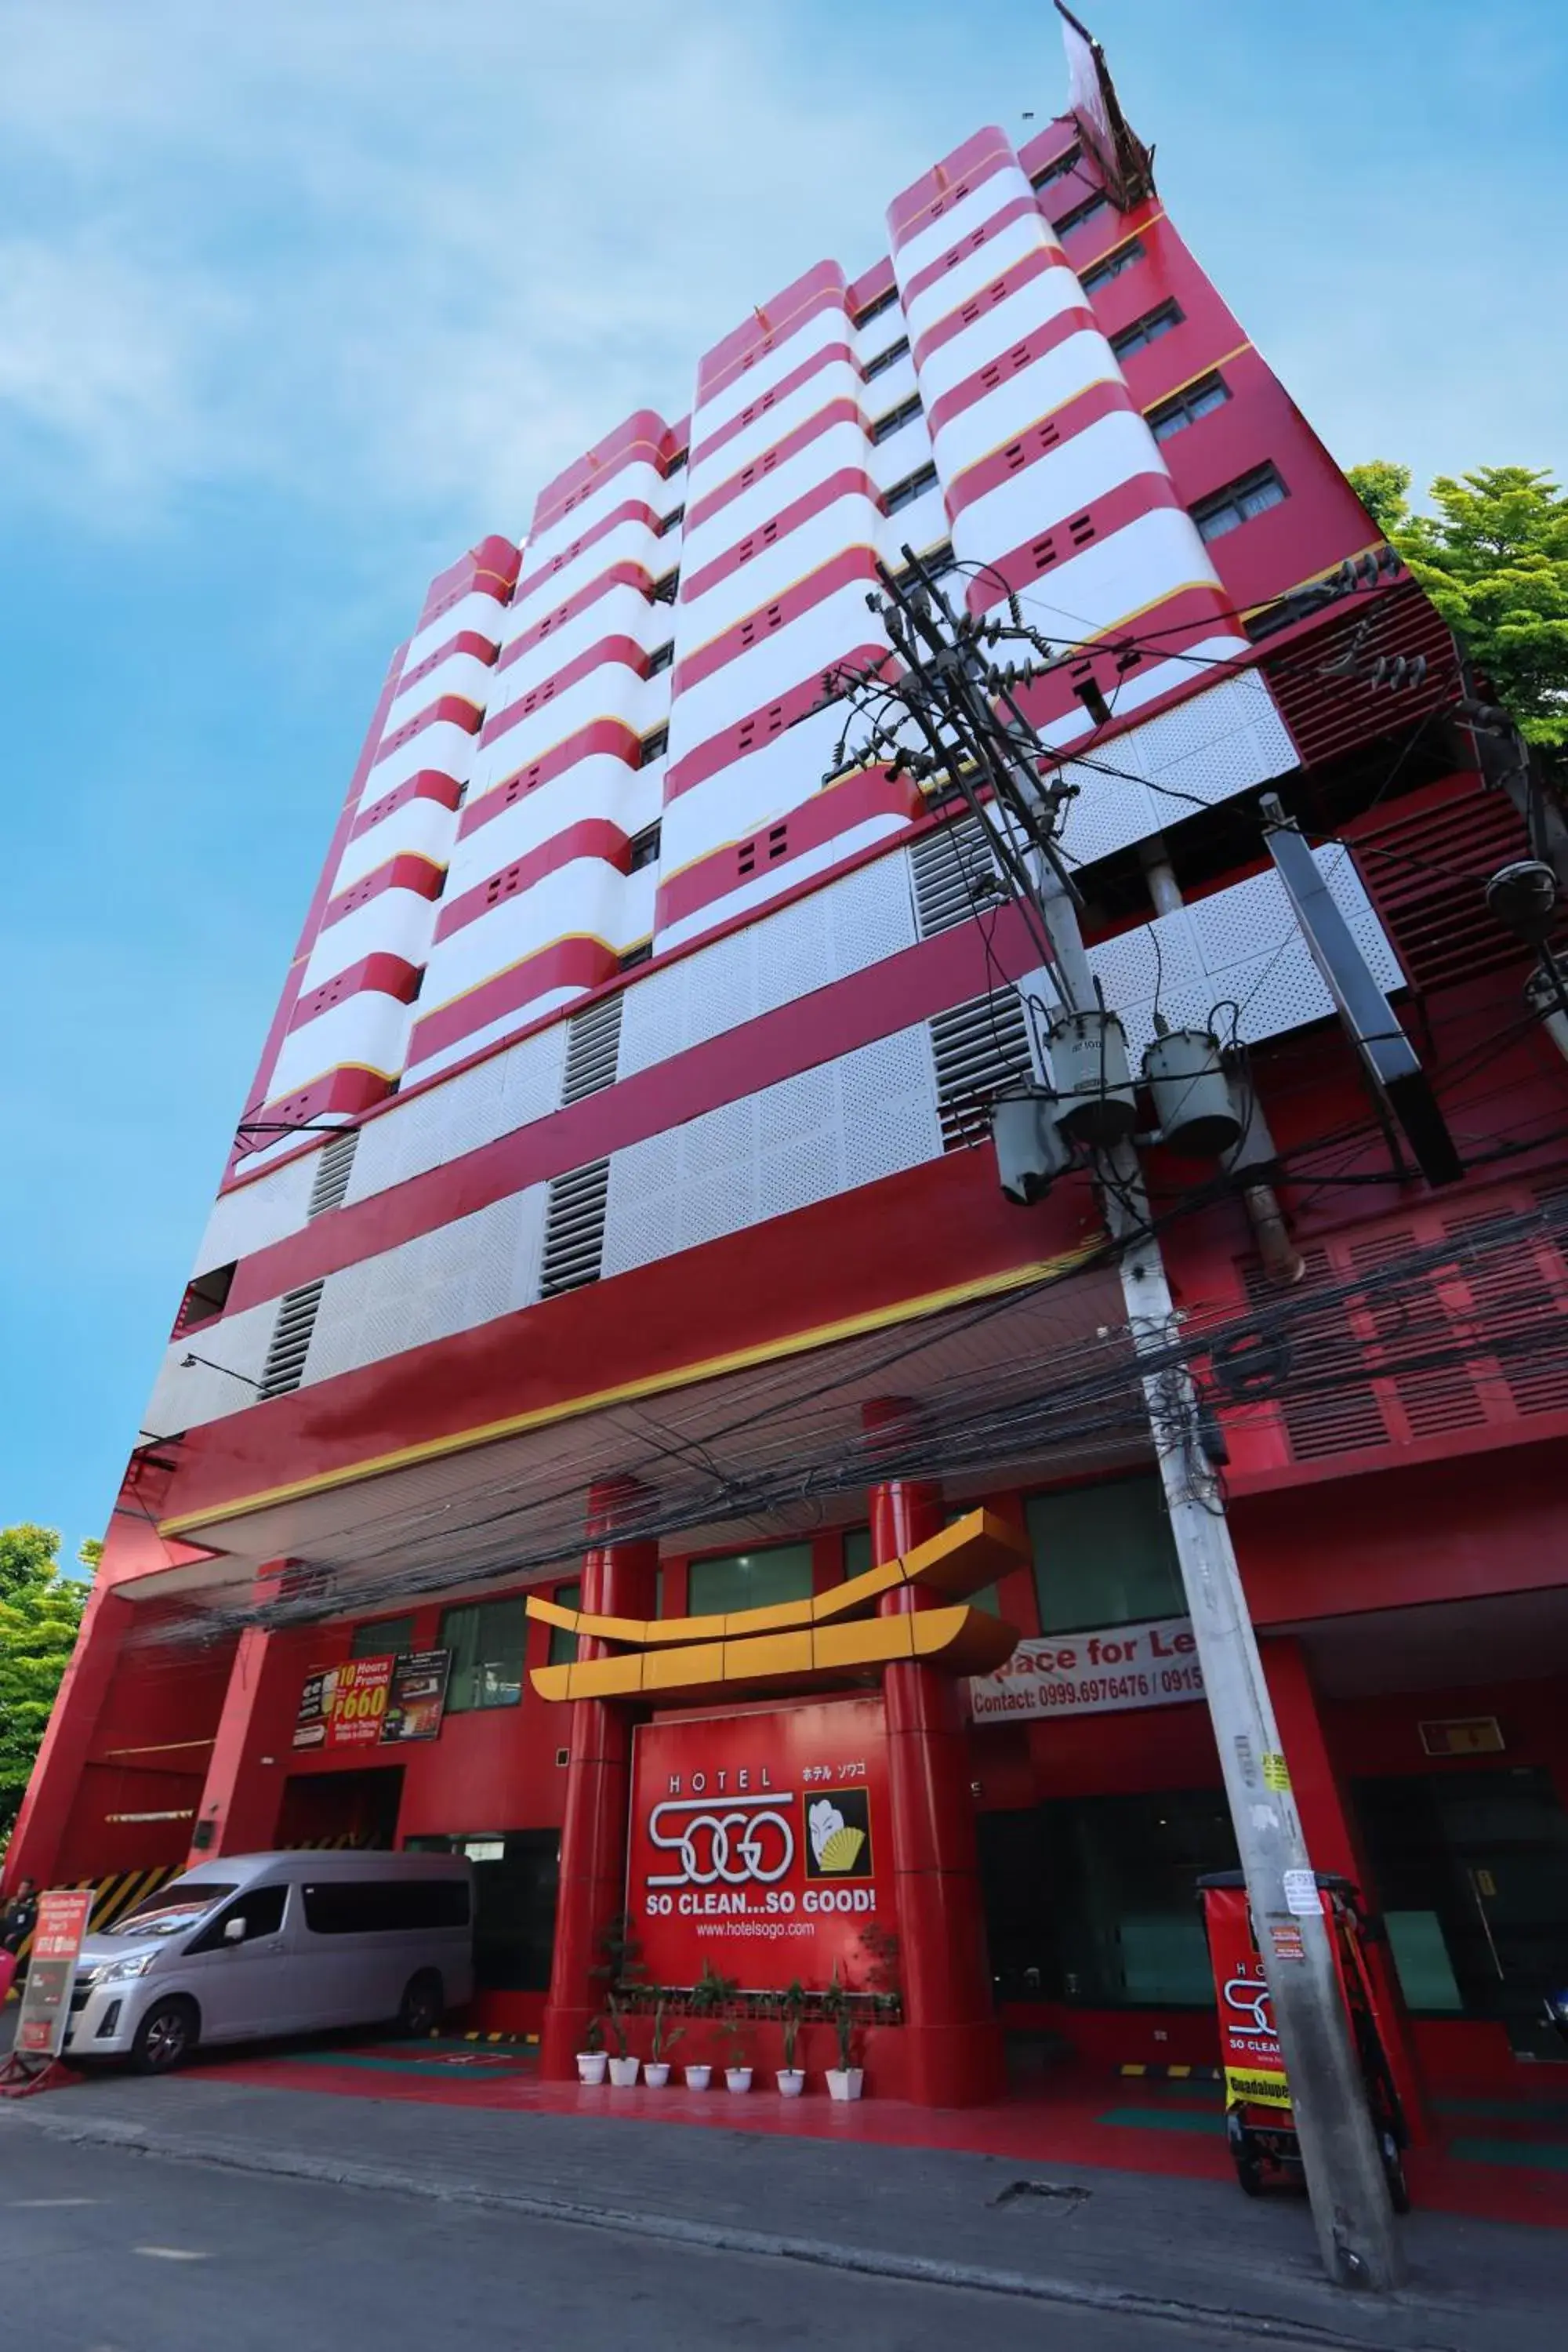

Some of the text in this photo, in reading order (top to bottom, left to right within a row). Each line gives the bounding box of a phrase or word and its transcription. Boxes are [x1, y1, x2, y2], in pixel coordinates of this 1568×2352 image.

[1087, 1638, 1137, 1665] for
[974, 1688, 1036, 1713] Contact:
[1039, 1672, 1148, 1707] 0999.6976476
[670, 1768, 771, 1792] HOTEL
[648, 1792, 793, 1886] SOGO
[646, 1894, 672, 1915] SO
[802, 1889, 877, 1912] GOOD!
[696, 1921, 815, 1939] www.hotelsogo.com
